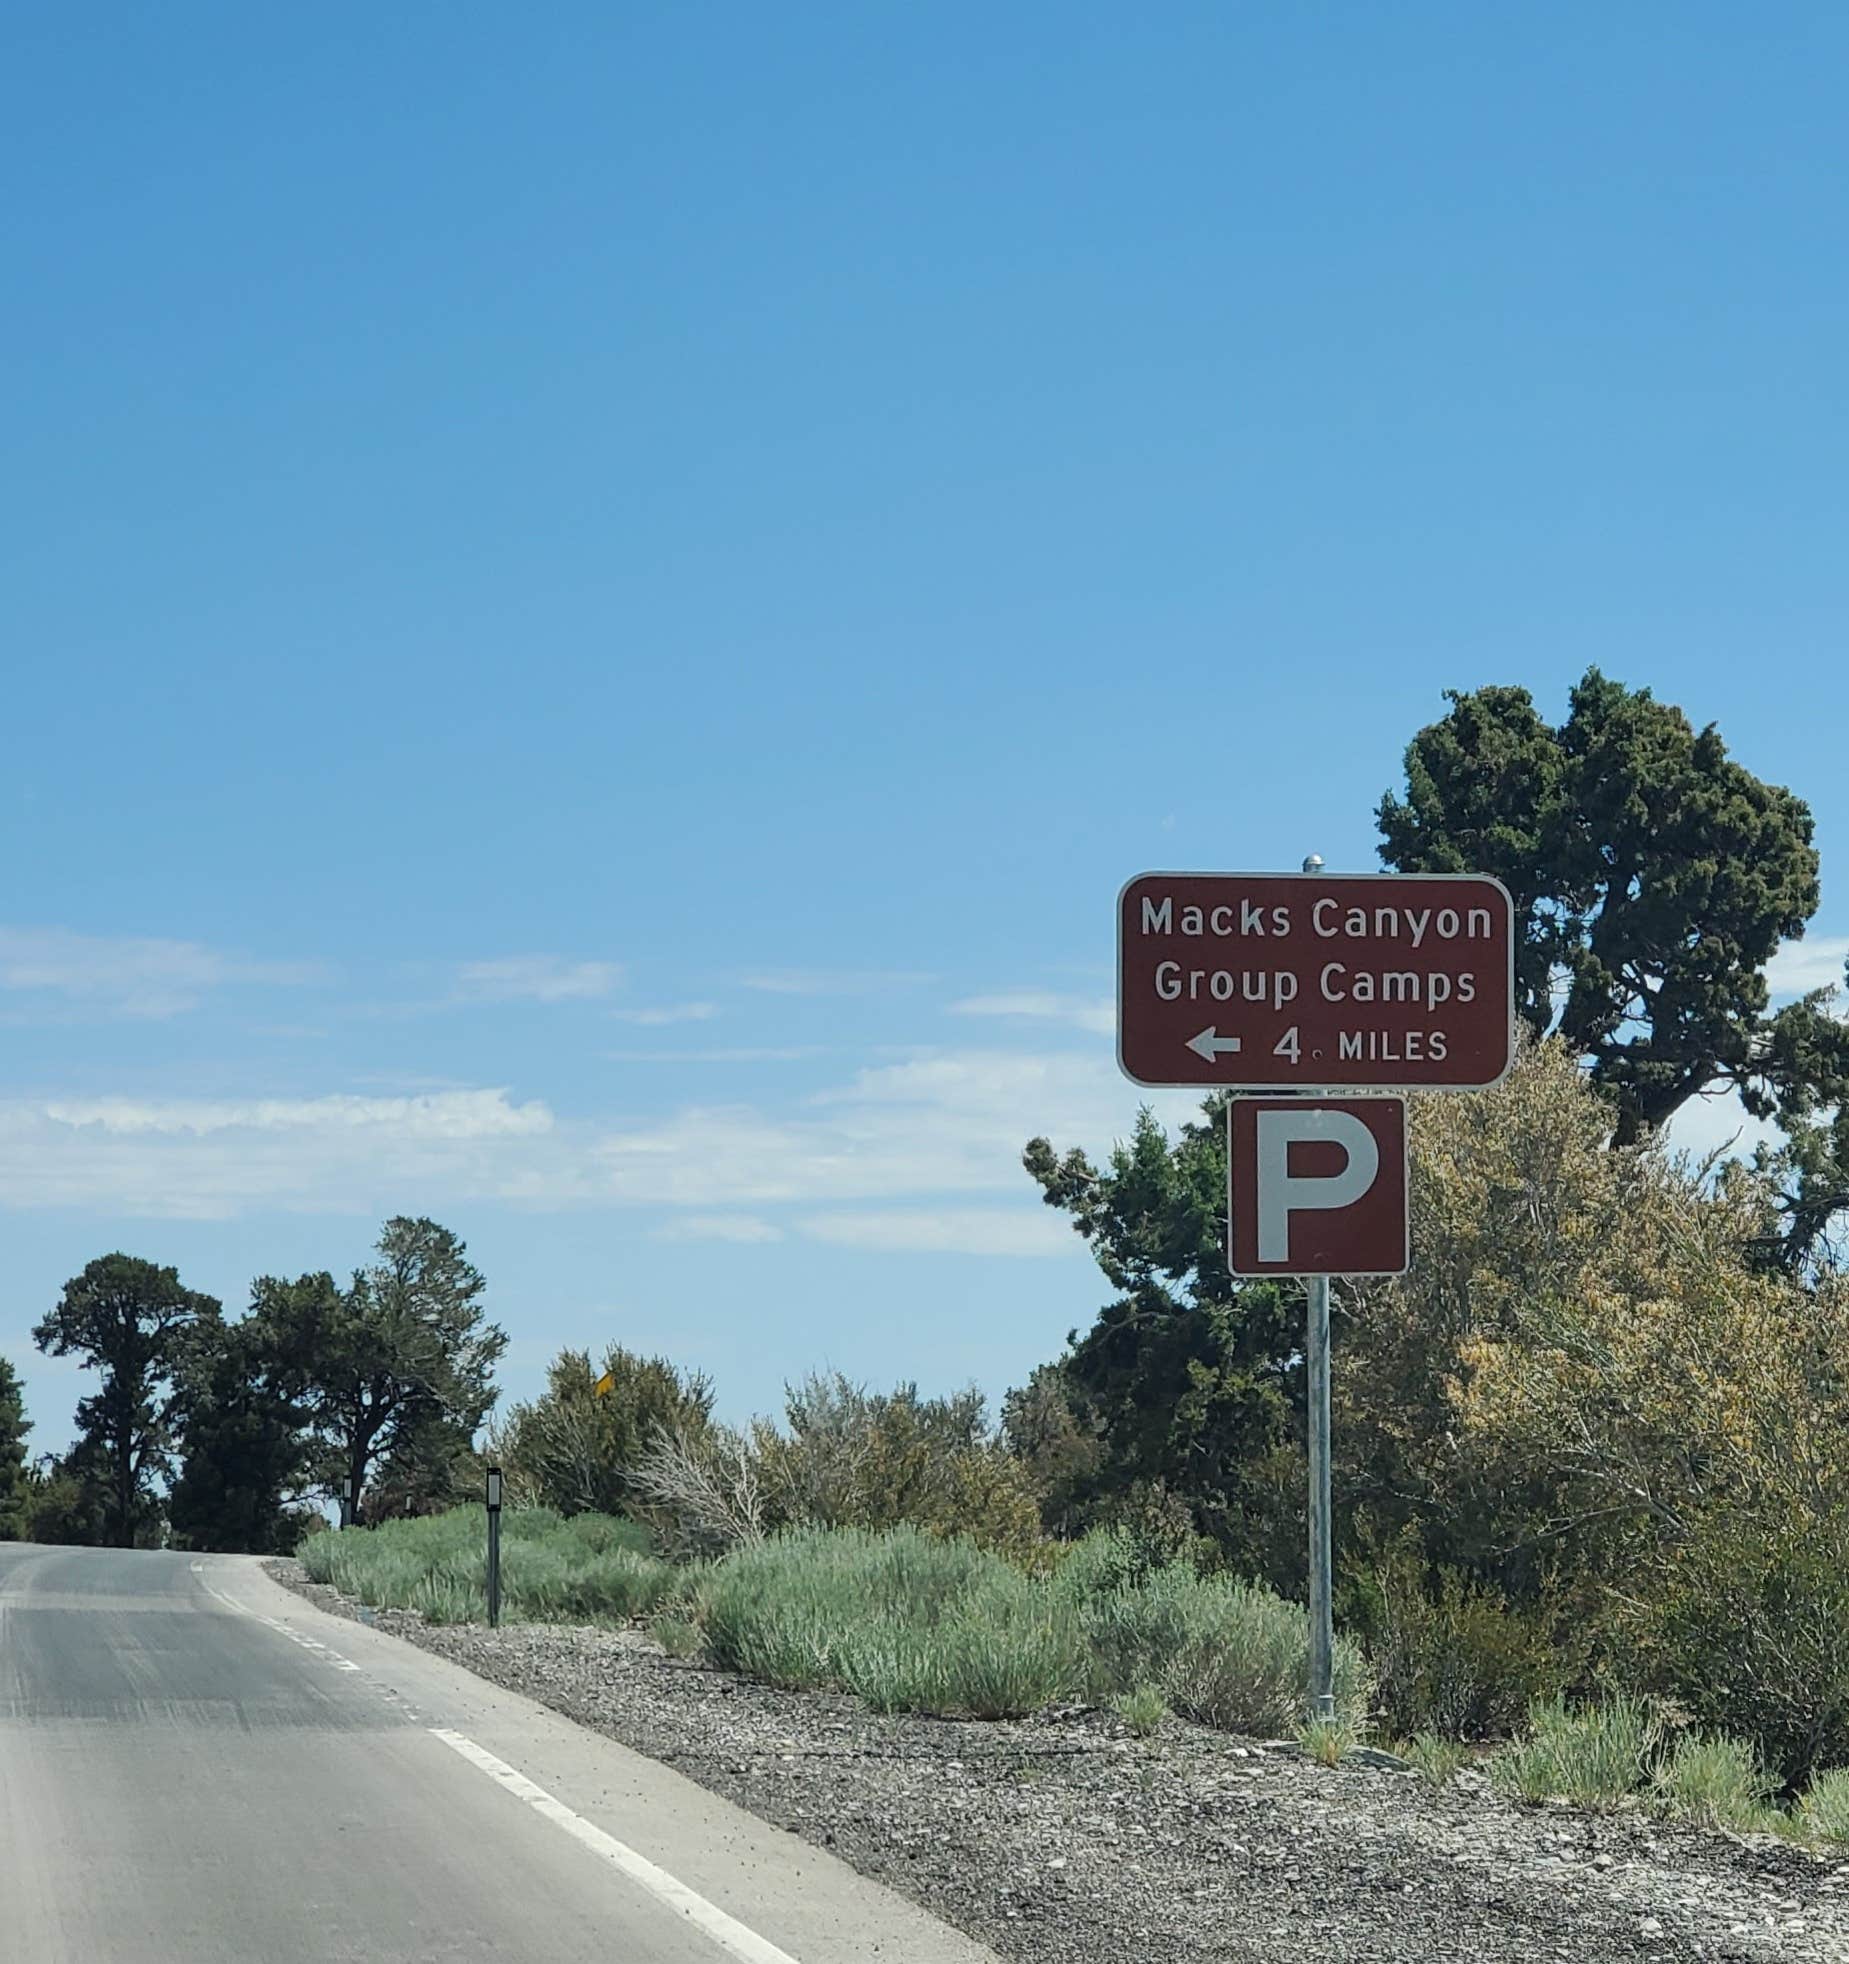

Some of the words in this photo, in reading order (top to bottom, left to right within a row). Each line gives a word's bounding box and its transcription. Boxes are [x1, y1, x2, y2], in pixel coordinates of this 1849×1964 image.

[1141, 897, 1291, 937] Macks
[1312, 898, 1492, 948] Canyon
[1155, 961, 1298, 1011] Group
[1320, 962, 1477, 1012] Camps
[1273, 1026, 1302, 1064] 4
[1339, 1031, 1448, 1061] MILES
[1257, 1109, 1380, 1263] P
